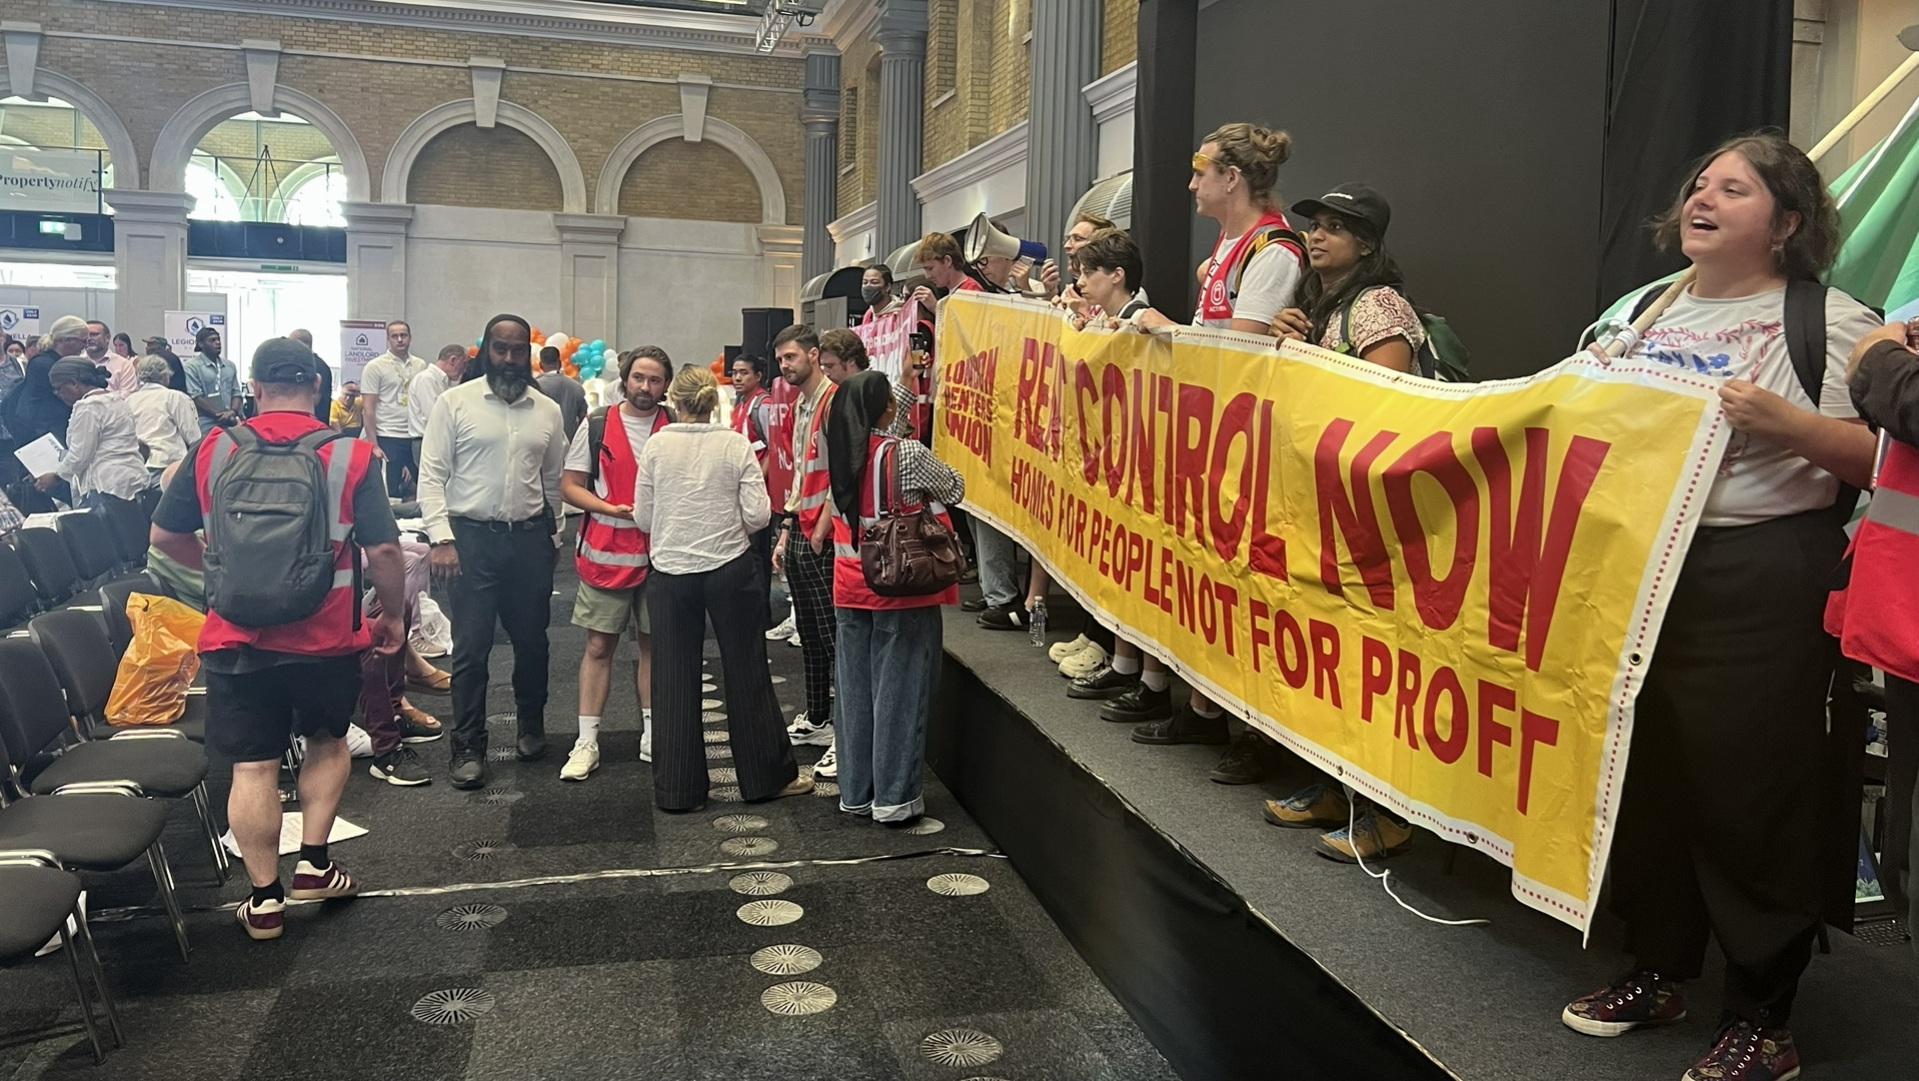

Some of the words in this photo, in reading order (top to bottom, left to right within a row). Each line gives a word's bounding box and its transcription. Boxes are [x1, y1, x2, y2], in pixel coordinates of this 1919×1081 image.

[1057, 487, 1087, 559] FOR
[1088, 508, 1173, 617] PEOPLE
[1176, 559, 1238, 657] NOT
[1247, 597, 1343, 711] FOR
[1314, 416, 1612, 672] NOW
